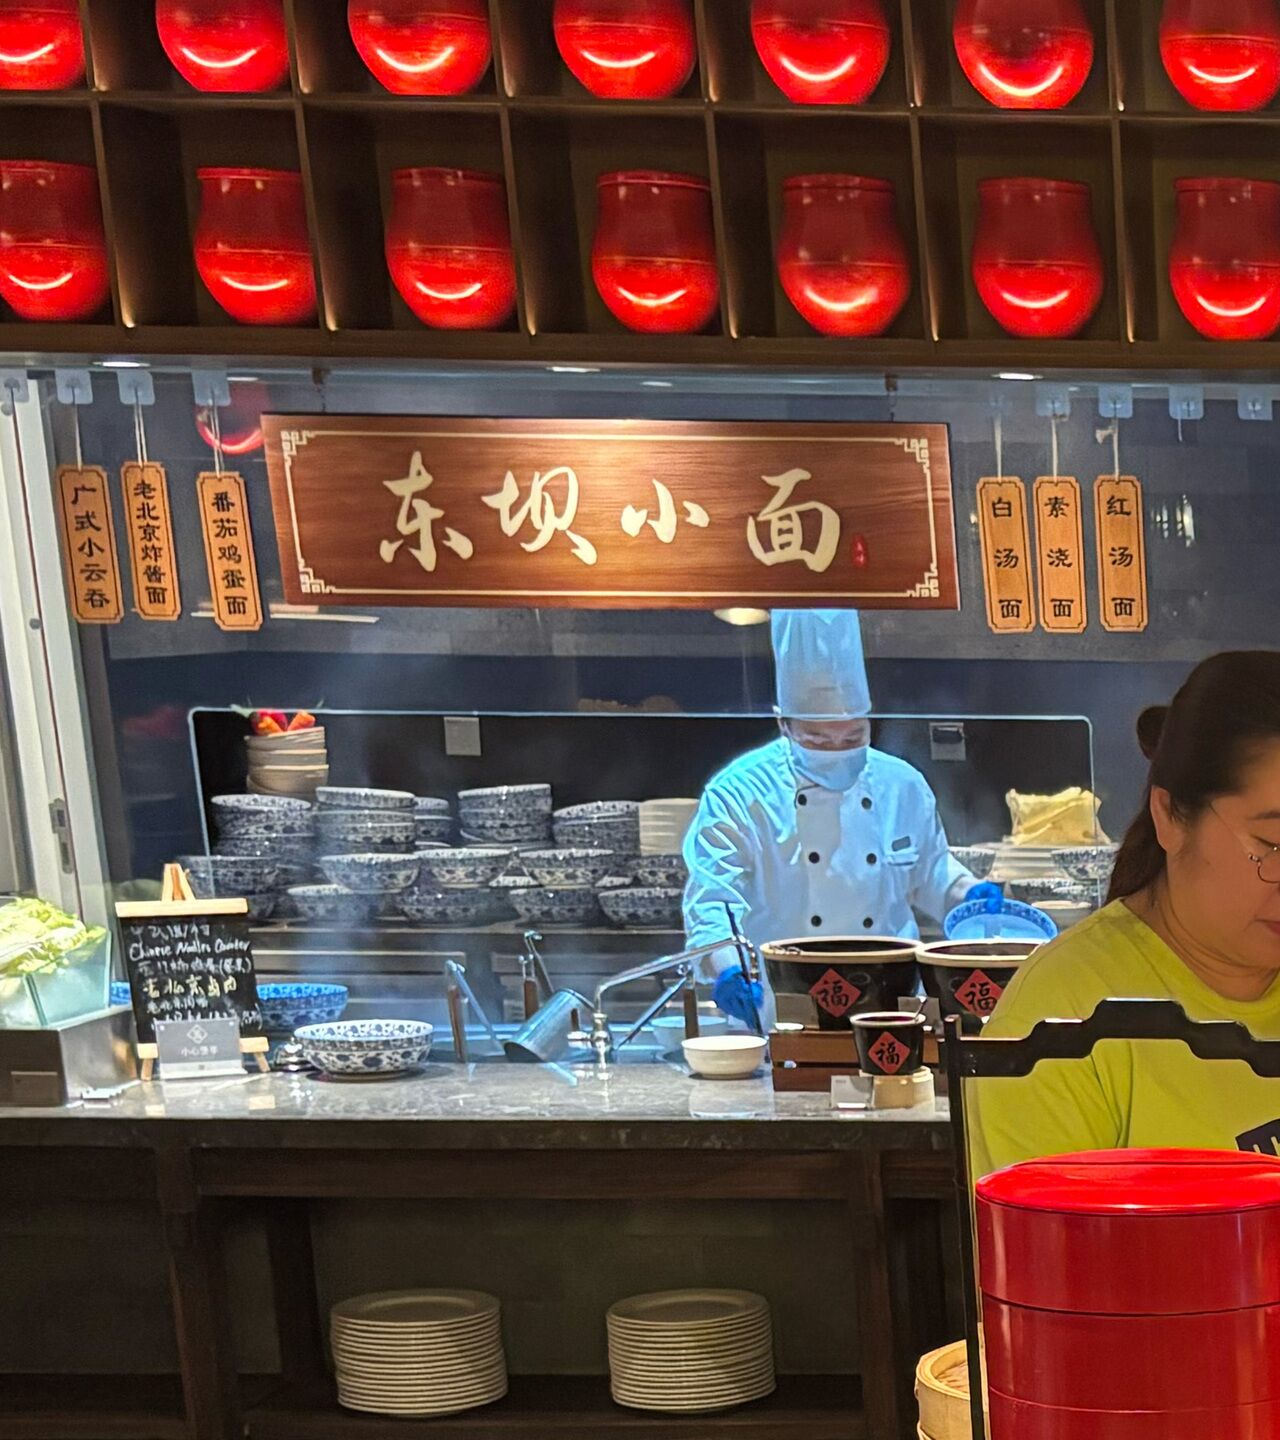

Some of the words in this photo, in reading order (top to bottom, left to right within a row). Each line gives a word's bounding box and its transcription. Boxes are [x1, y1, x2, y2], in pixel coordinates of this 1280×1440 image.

[71, 484, 111, 609] 广式小云吞
[134, 480, 168, 605] 老北京炸酱面
[211, 491, 248, 615] 番茄鸡蛋面
[380, 451, 841, 573] 东坝小面
[991, 496, 1022, 619] 白汤面
[1044, 495, 1074, 618] 素浇面
[1106, 495, 1136, 617] 红汤面
[816, 979, 850, 1008] 福
[875, 1041, 900, 1066] 福
[964, 981, 996, 1011] 福
